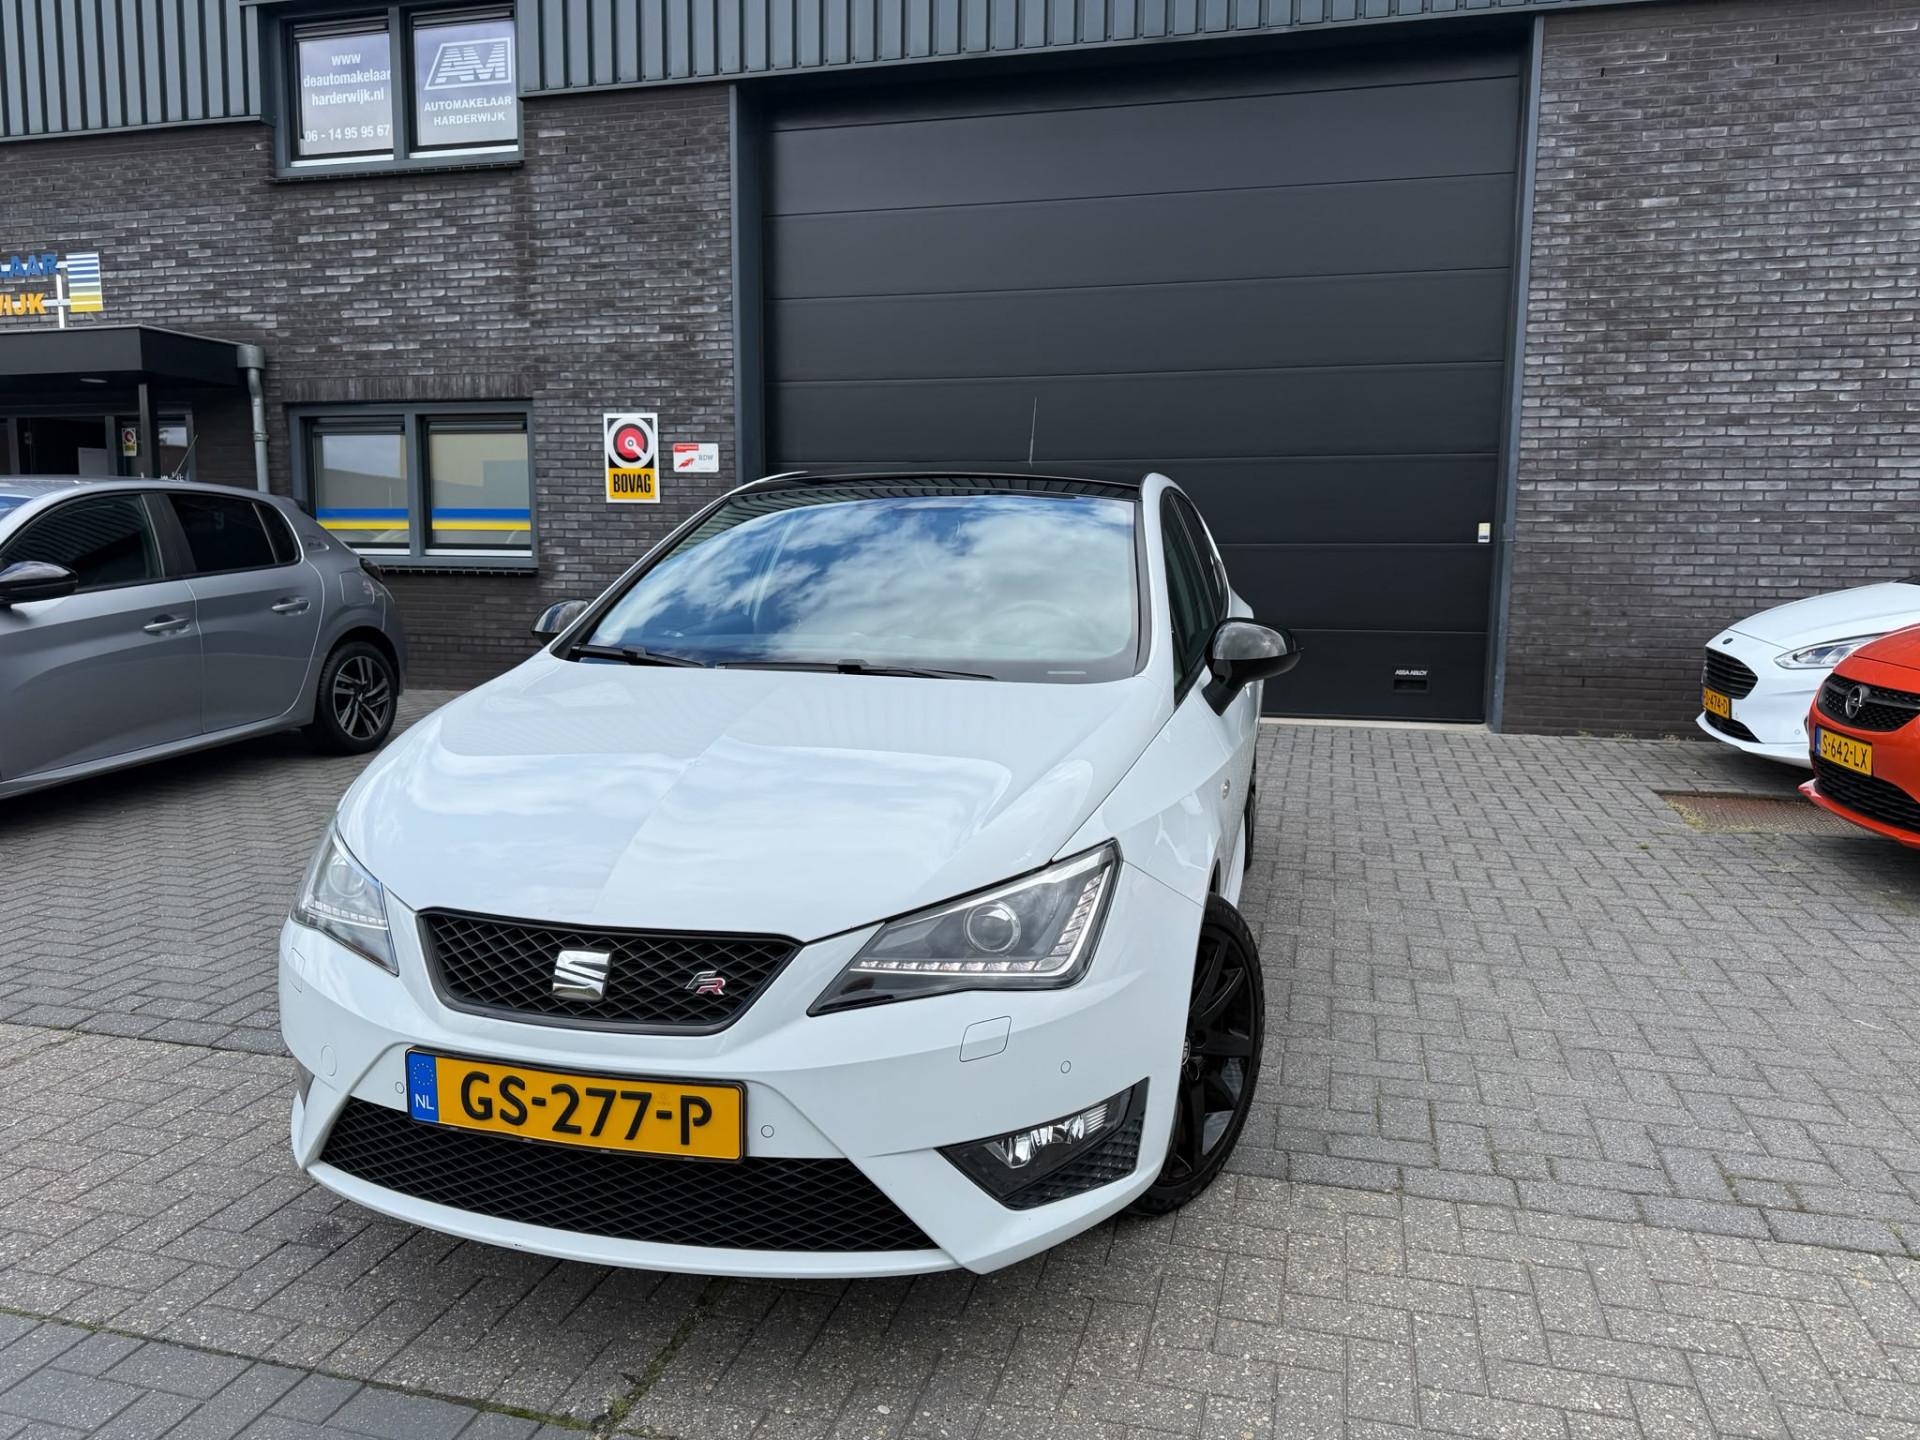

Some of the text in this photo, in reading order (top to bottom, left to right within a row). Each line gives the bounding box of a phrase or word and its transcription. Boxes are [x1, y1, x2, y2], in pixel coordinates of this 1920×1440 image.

[331, 53, 361, 66] www
[303, 69, 391, 88] deautomakelaar
[312, 87, 385, 106] harderwijk.nl
[424, 96, 512, 112] AUTOMAKELAAR
[433, 112, 506, 126] HARDERWIJK
[305, 130, 318, 142] 06
[328, 128, 342, 141] 14
[344, 127, 358, 140] 95
[360, 125, 374, 138] 95
[376, 124, 390, 137] 67
[0, 293, 46, 316] IJK
[613, 473, 652, 494] BOVAG
[1822, 734, 1868, 771] S-642-LX
[685, 970, 726, 996] FR
[415, 1093, 435, 1110] NL
[460, 1070, 713, 1146] GS-277-P
